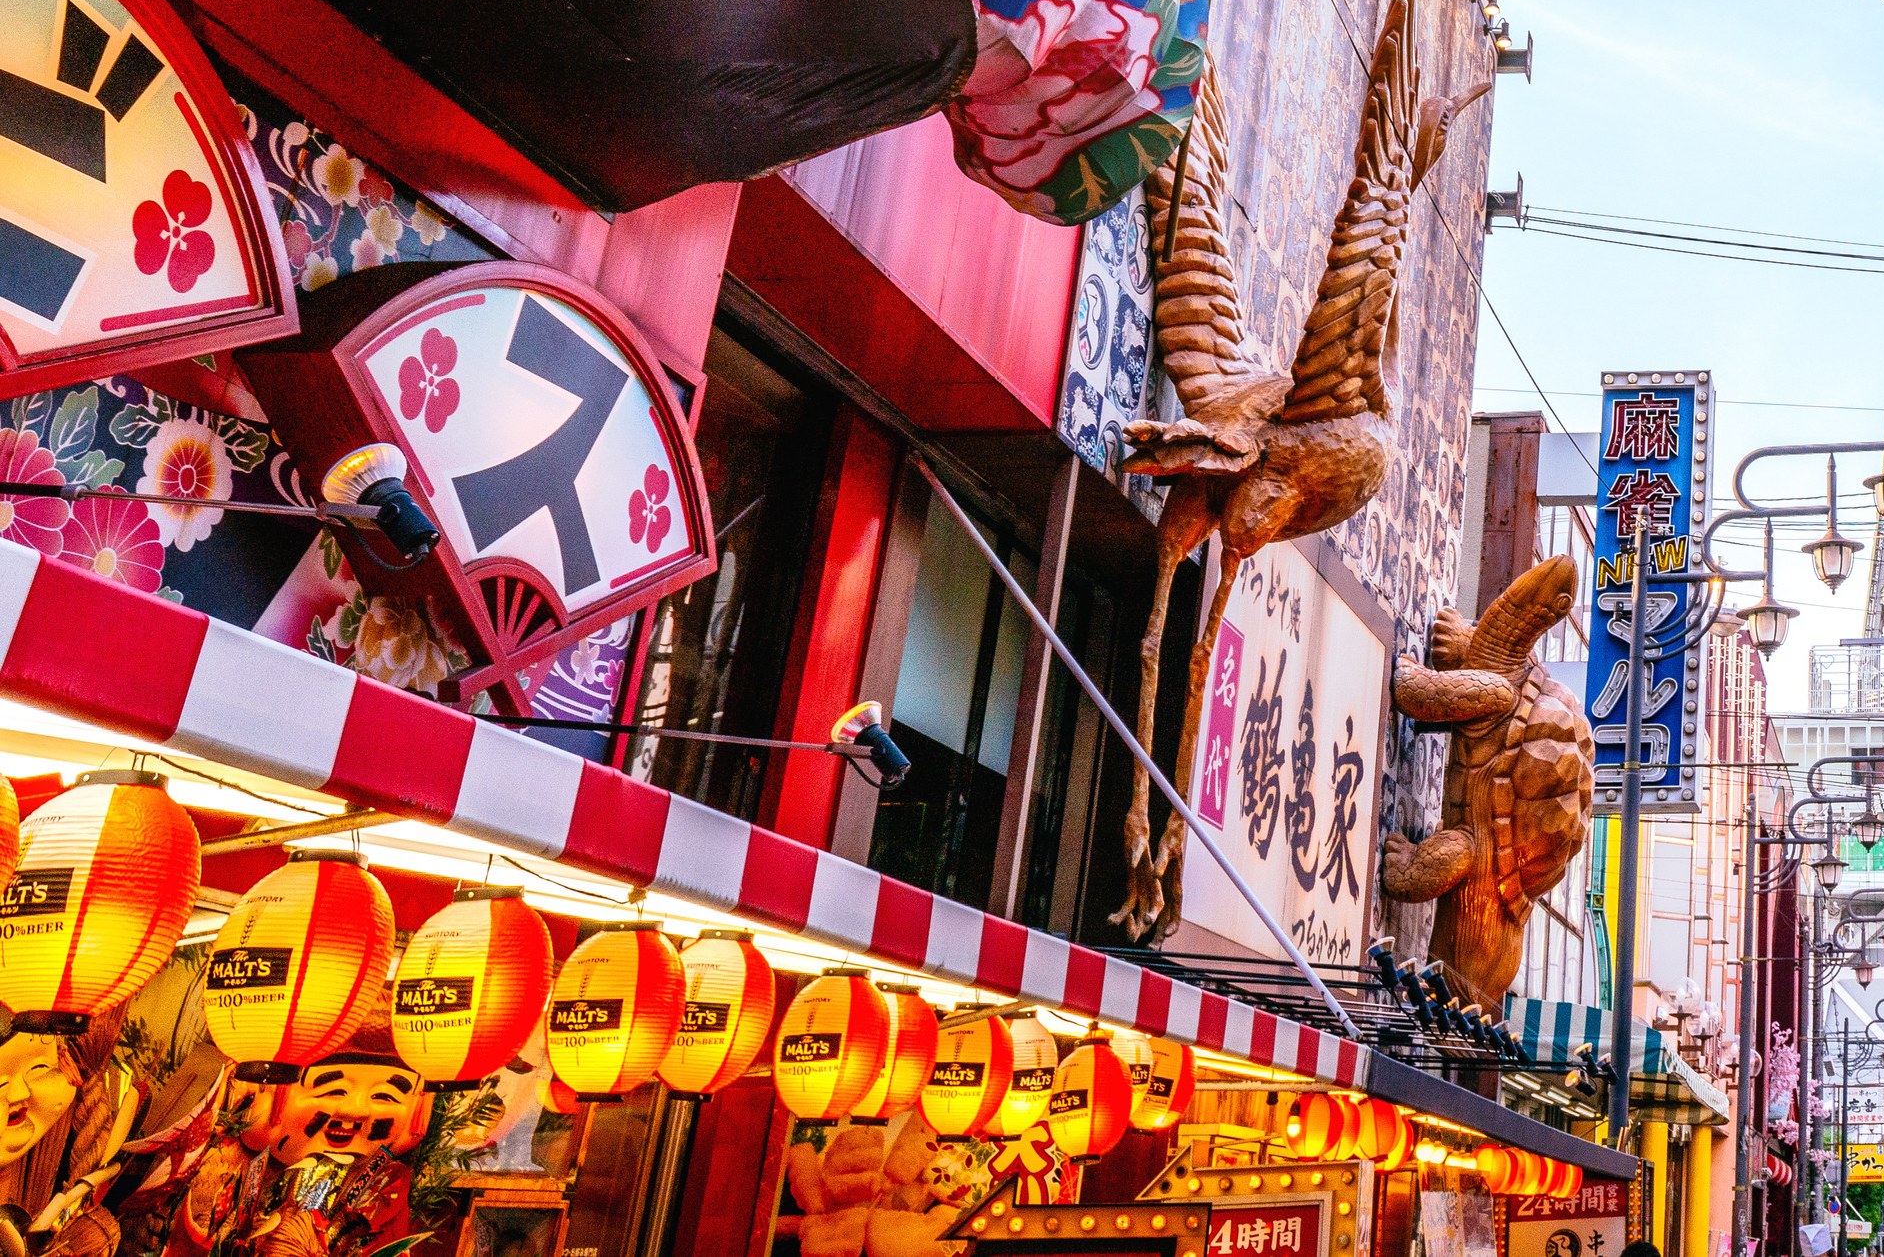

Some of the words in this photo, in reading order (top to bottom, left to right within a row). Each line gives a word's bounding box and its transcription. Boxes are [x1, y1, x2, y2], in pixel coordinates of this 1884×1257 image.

[1601, 392, 1680, 539] 麻雀
[212, 957, 272, 979] MALT'S
[401, 986, 458, 1006] MALT'S
[556, 1007, 609, 1025] MALT'S
[682, 1009, 717, 1025] ALT'S
[785, 1040, 830, 1056] MALT'S
[934, 1068, 976, 1081] MALT'S
[1019, 1073, 1052, 1087] MALT'S
[1208, 1216, 1303, 1255] 4時間
